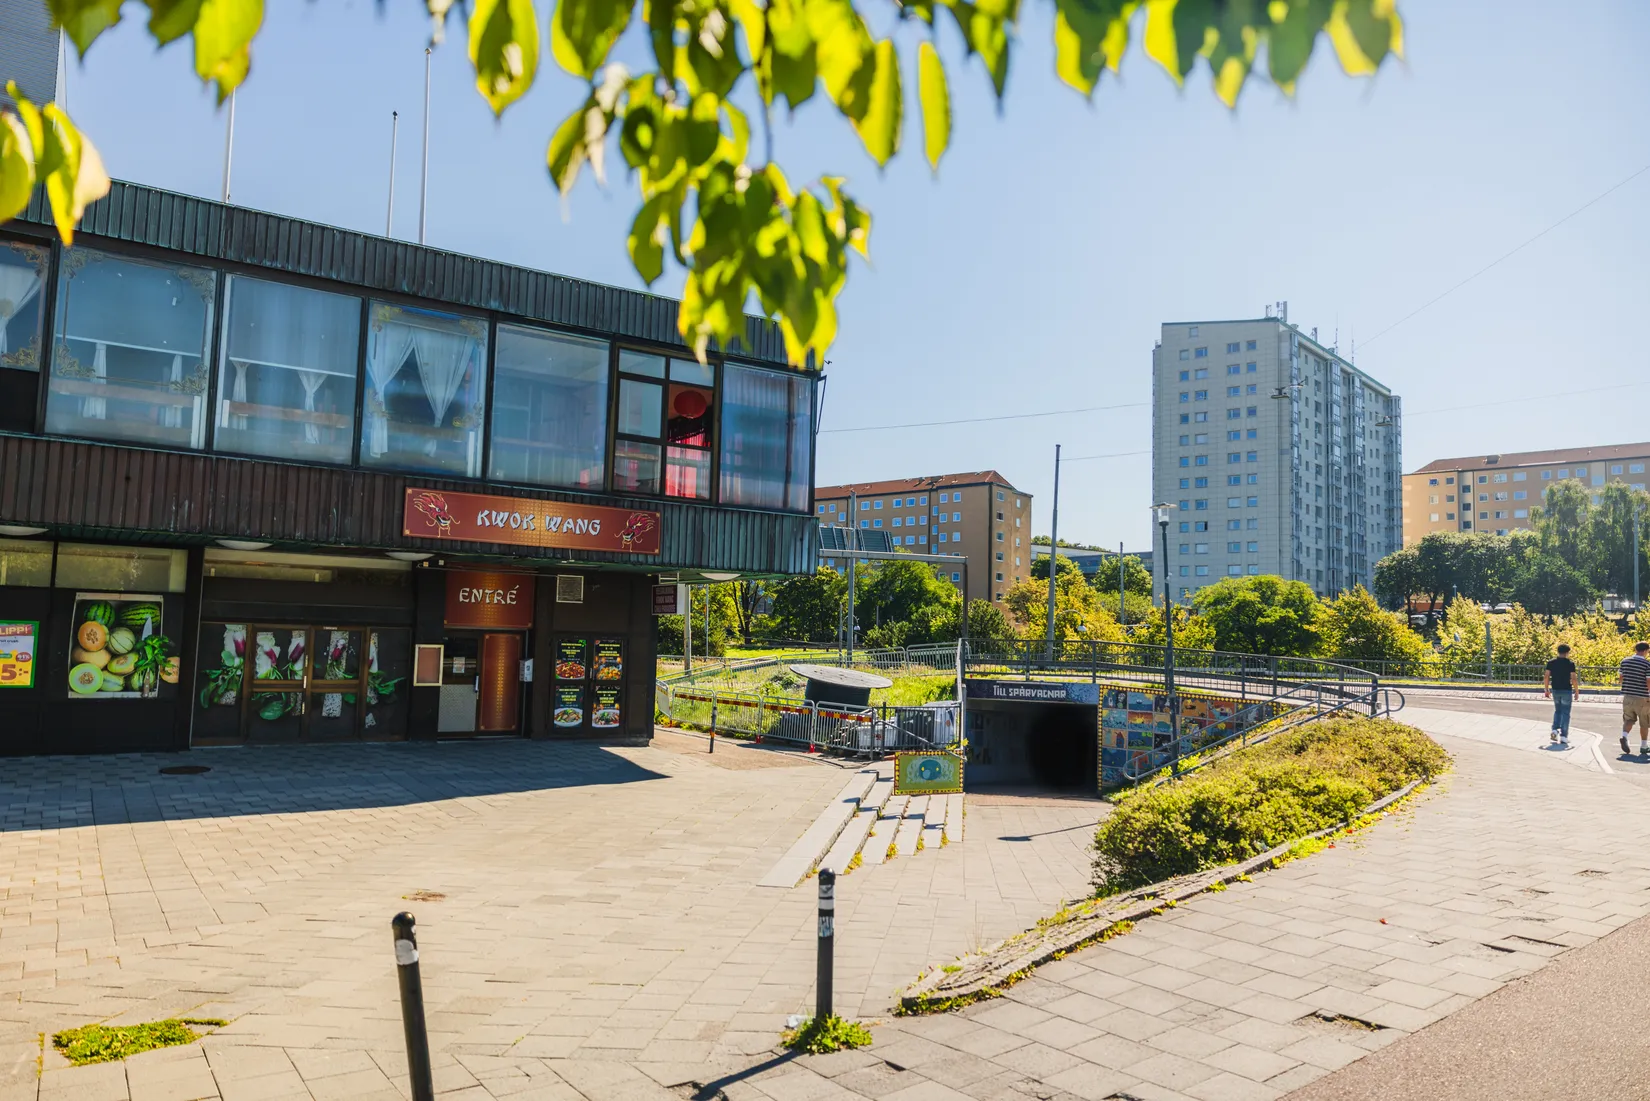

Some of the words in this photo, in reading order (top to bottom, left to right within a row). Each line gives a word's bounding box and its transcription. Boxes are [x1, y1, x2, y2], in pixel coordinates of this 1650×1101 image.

[477, 509, 536, 531] KWOK
[545, 514, 601, 536] WANG
[459, 585, 519, 604] ENTRÉ
